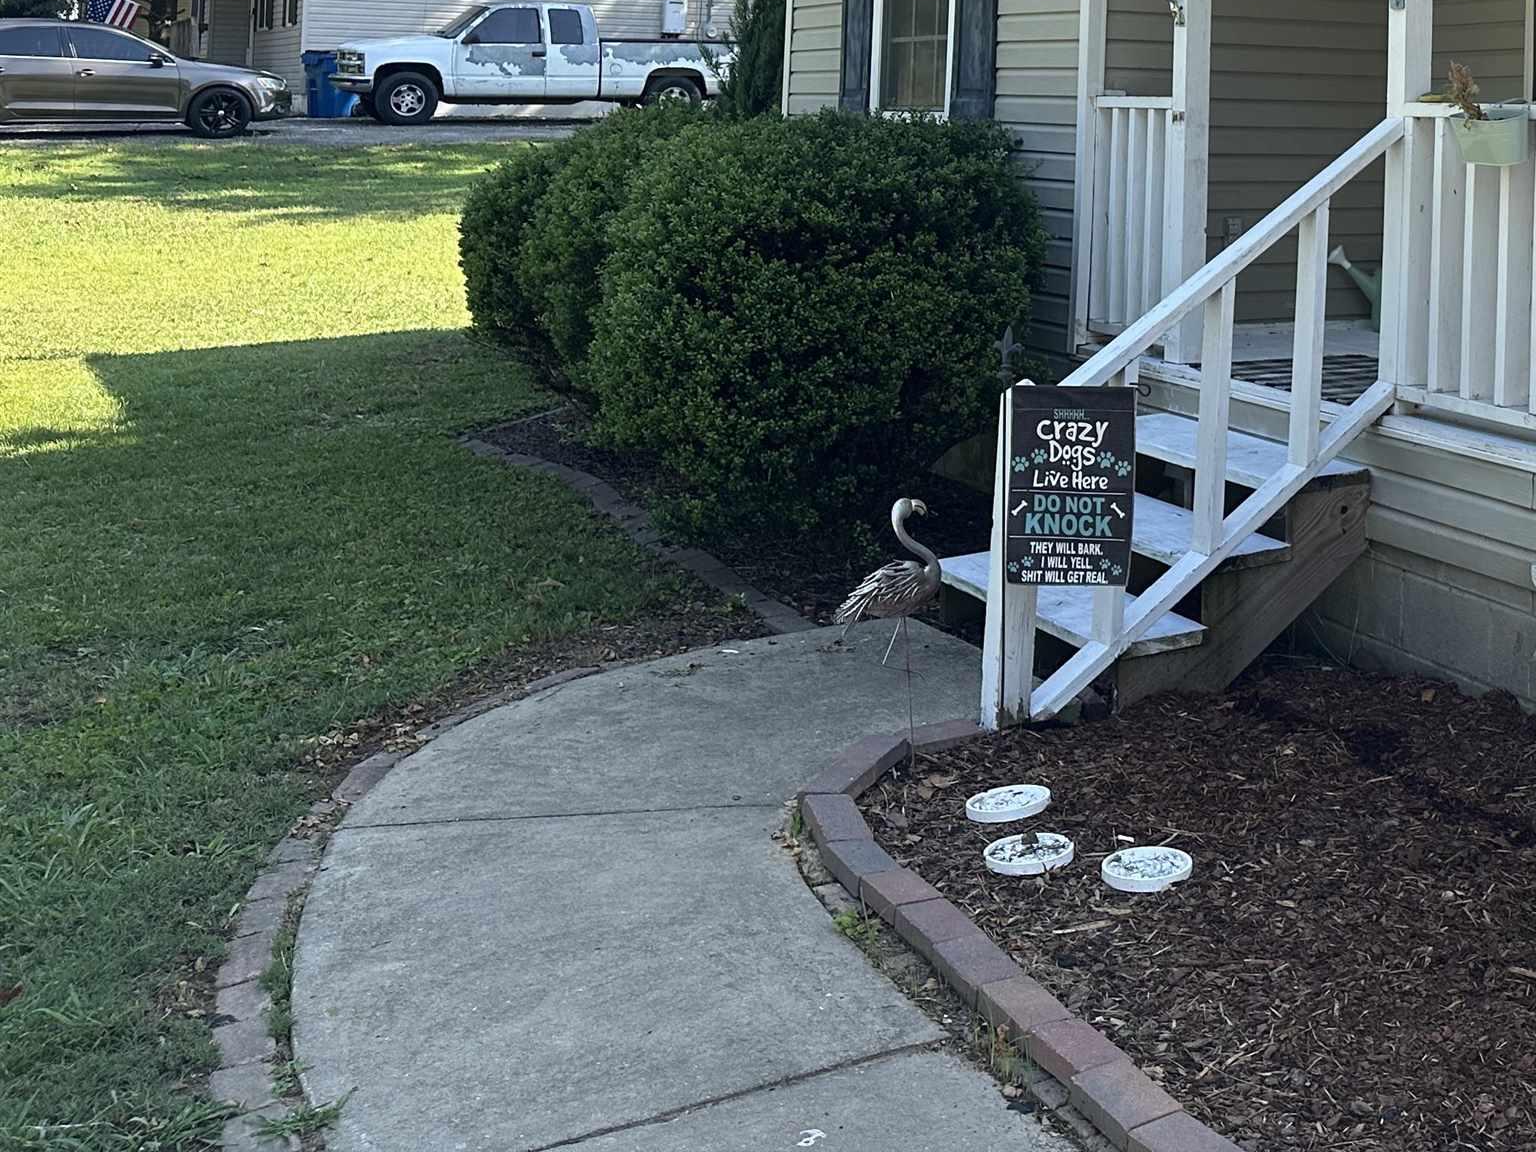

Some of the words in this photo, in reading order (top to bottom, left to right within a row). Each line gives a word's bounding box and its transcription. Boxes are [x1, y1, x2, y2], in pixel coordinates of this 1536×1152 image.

[1036, 419, 1109, 448] Crazy
[1049, 440, 1096, 471] Dogs
[1033, 469, 1069, 488] Live
[1072, 471, 1108, 490] Here
[1033, 494, 1060, 512] DO
[1065, 496, 1105, 514] NOT
[1024, 512, 1112, 537] KNOCK
[1030, 541, 1054, 554] THEY
[1056, 542, 1076, 554] WILL
[1078, 542, 1103, 555] BARK.
[1041, 556, 1045, 568] I
[1047, 556, 1068, 568] WILL
[1070, 556, 1093, 569] YELL.
[1021, 570, 1043, 582] SHIT
[1044, 570, 1065, 583] WILL
[1067, 571, 1084, 583] GET
[1085, 571, 1108, 584] REAL.
